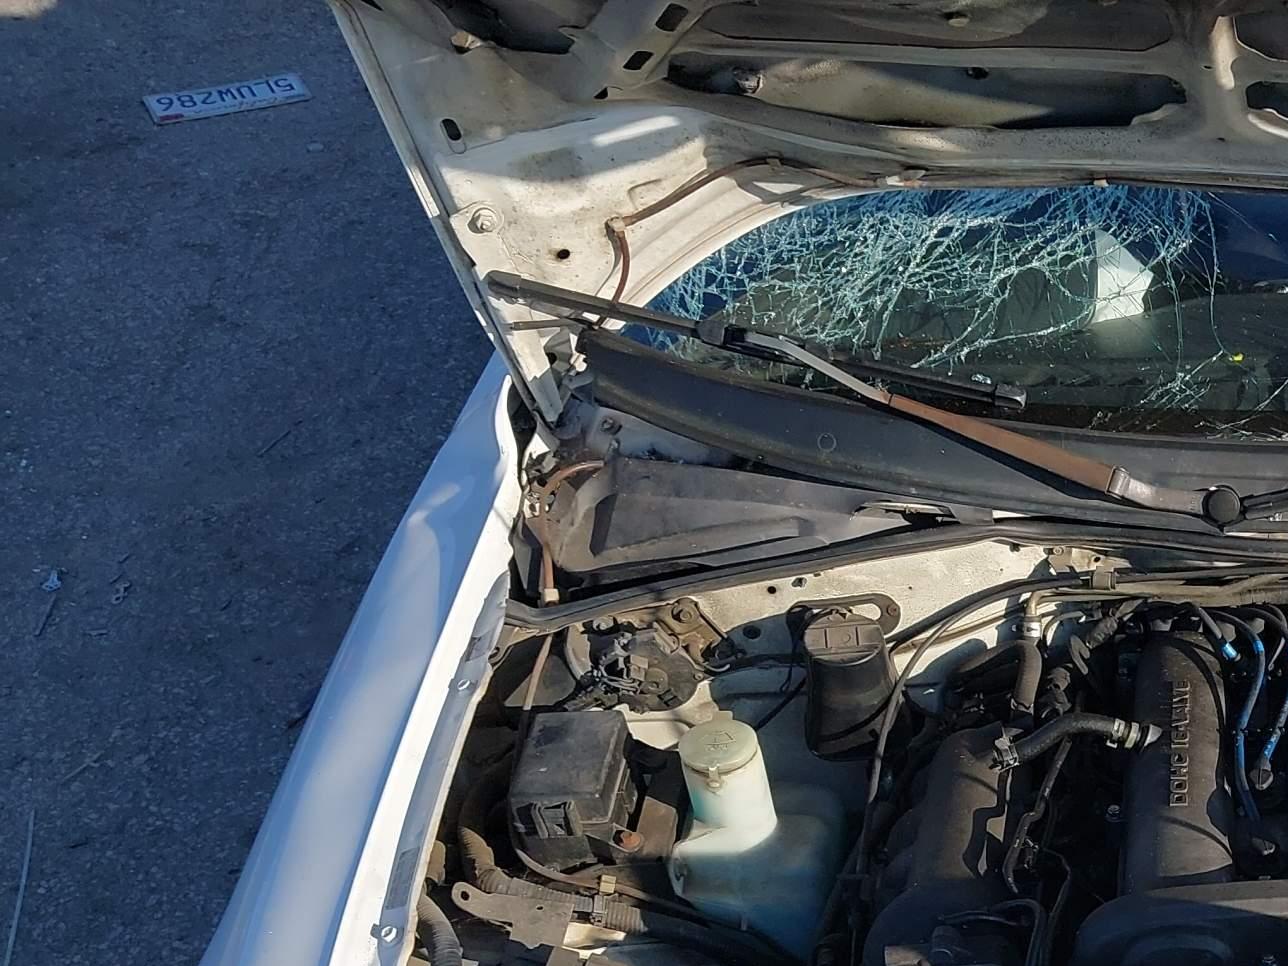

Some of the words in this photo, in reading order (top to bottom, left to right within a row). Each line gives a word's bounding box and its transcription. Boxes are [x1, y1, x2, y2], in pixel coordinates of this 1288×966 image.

[155, 78, 296, 112] 5LUW286
[1171, 679, 1191, 727] VALVE
[1171, 726, 1190, 749] 16
[1169, 752, 1189, 806] DOHC
